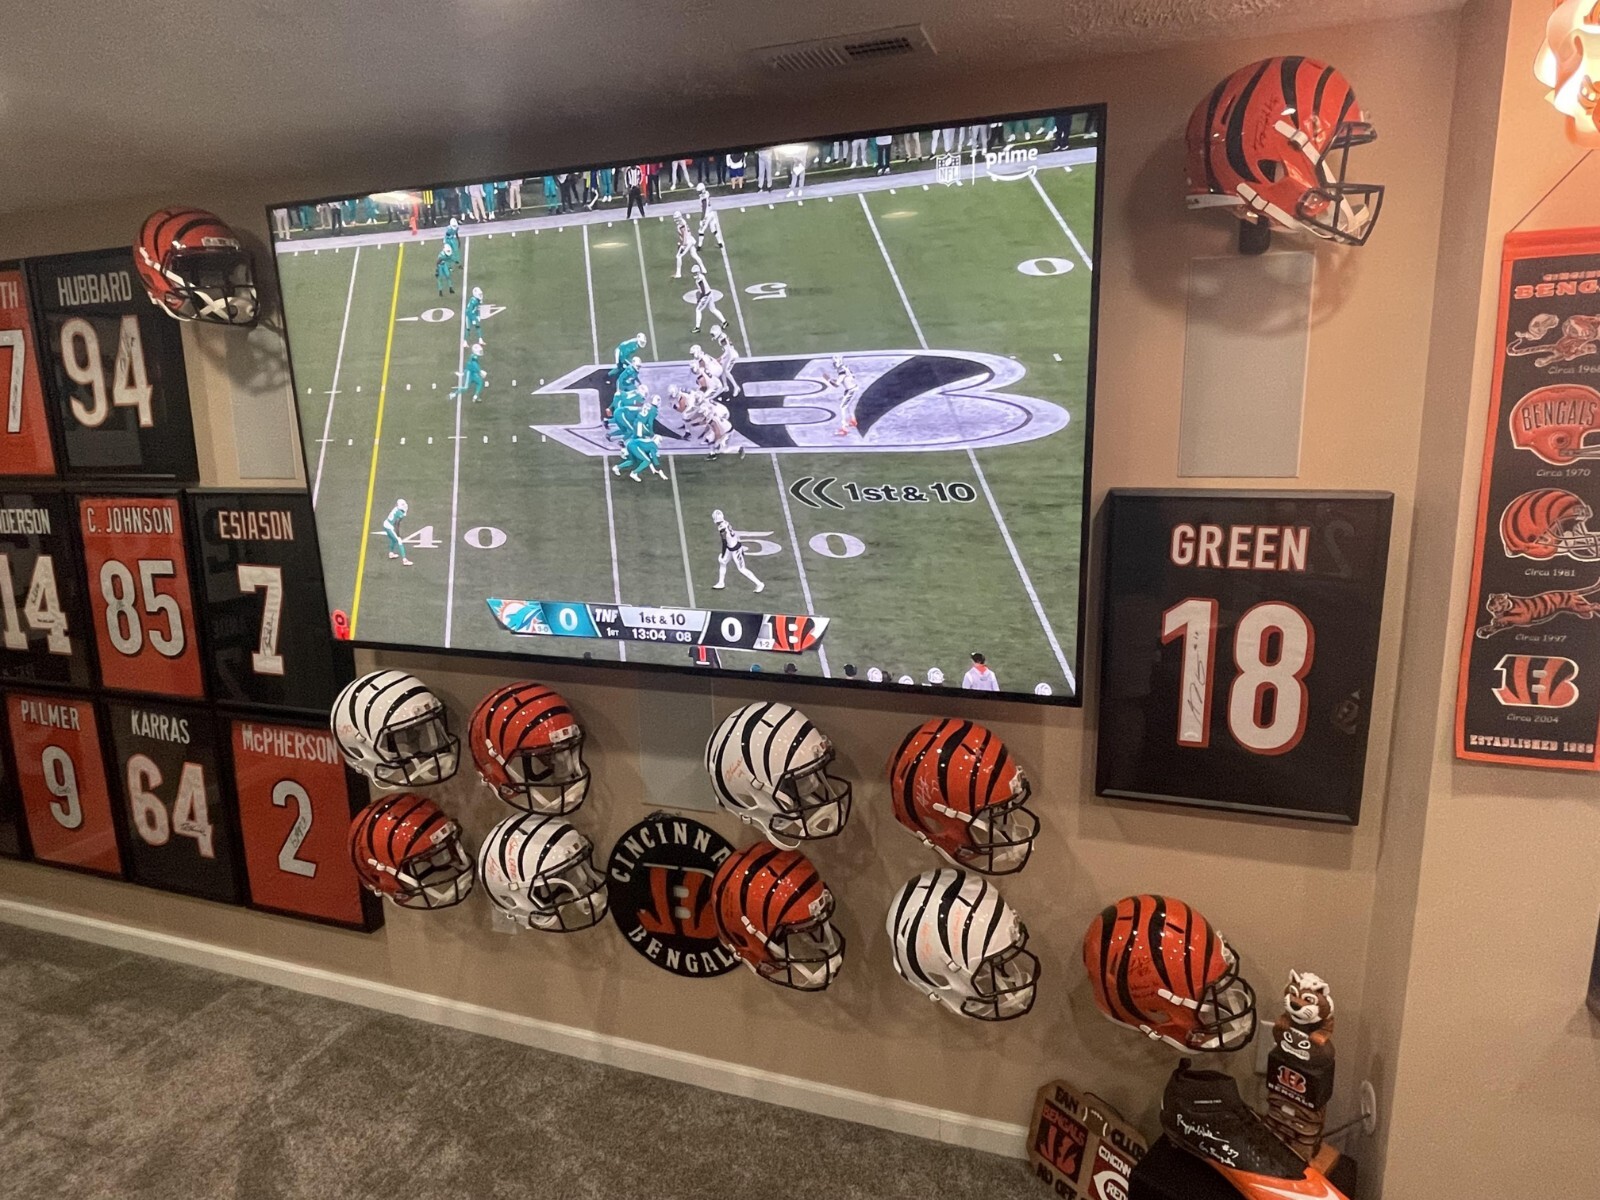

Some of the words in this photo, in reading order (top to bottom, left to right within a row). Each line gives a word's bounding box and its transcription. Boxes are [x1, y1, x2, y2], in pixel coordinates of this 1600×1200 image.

[985, 148, 1038, 169] prime
[57, 271, 132, 306] HUBBARD
[1514, 280, 1600, 299] BENG
[60, 314, 153, 428] 94
[1521, 401, 1598, 431] BENGALS
[1536, 469, 1563, 478] Circa
[1565, 468, 1591, 477] 1970
[842, 482, 899, 502] 1st
[902, 486, 930, 502] &
[929, 482, 977, 503] 10
[0, 508, 51, 535] DERSON
[86, 507, 103, 533] C.
[106, 507, 174, 534] JOHNSON
[217, 510, 294, 541] ESIASON
[1170, 522, 1310, 573] GREEN
[1524, 568, 1550, 577] Circa
[1552, 568, 1576, 577] 1981
[0, 553, 72, 655] 14
[100, 559, 186, 657] 85
[595, 609, 618, 623] TNF
[237, 563, 285, 676] 7
[558, 607, 578, 632] 0
[639, 611, 656, 625] 1st
[658, 616, 668, 625] &
[670, 613, 686, 626] 10
[720, 616, 743, 642] 0
[631, 628, 667, 641] 13:04
[675, 631, 692, 642] 08
[1515, 633, 1541, 642] Circa
[1543, 633, 1567, 642] 1997
[1161, 597, 1316, 756] 18
[21, 699, 81, 732] PALMER
[131, 709, 190, 745] KARRAS
[1506, 713, 1532, 723] Circa
[1534, 714, 1559, 723] 2004
[242, 723, 339, 765] McPHERSON
[1469, 734, 1558, 751] ESTABLISHED
[41, 745, 83, 829] 9
[126, 753, 215, 859] 64
[271, 780, 317, 878] 2
[1055, 1086, 1079, 1113] FAN
[1268, 1082, 1314, 1109] BENGALS
[1042, 1105, 1087, 1145] BENGALS
[1037, 1163, 1053, 1185] NO
